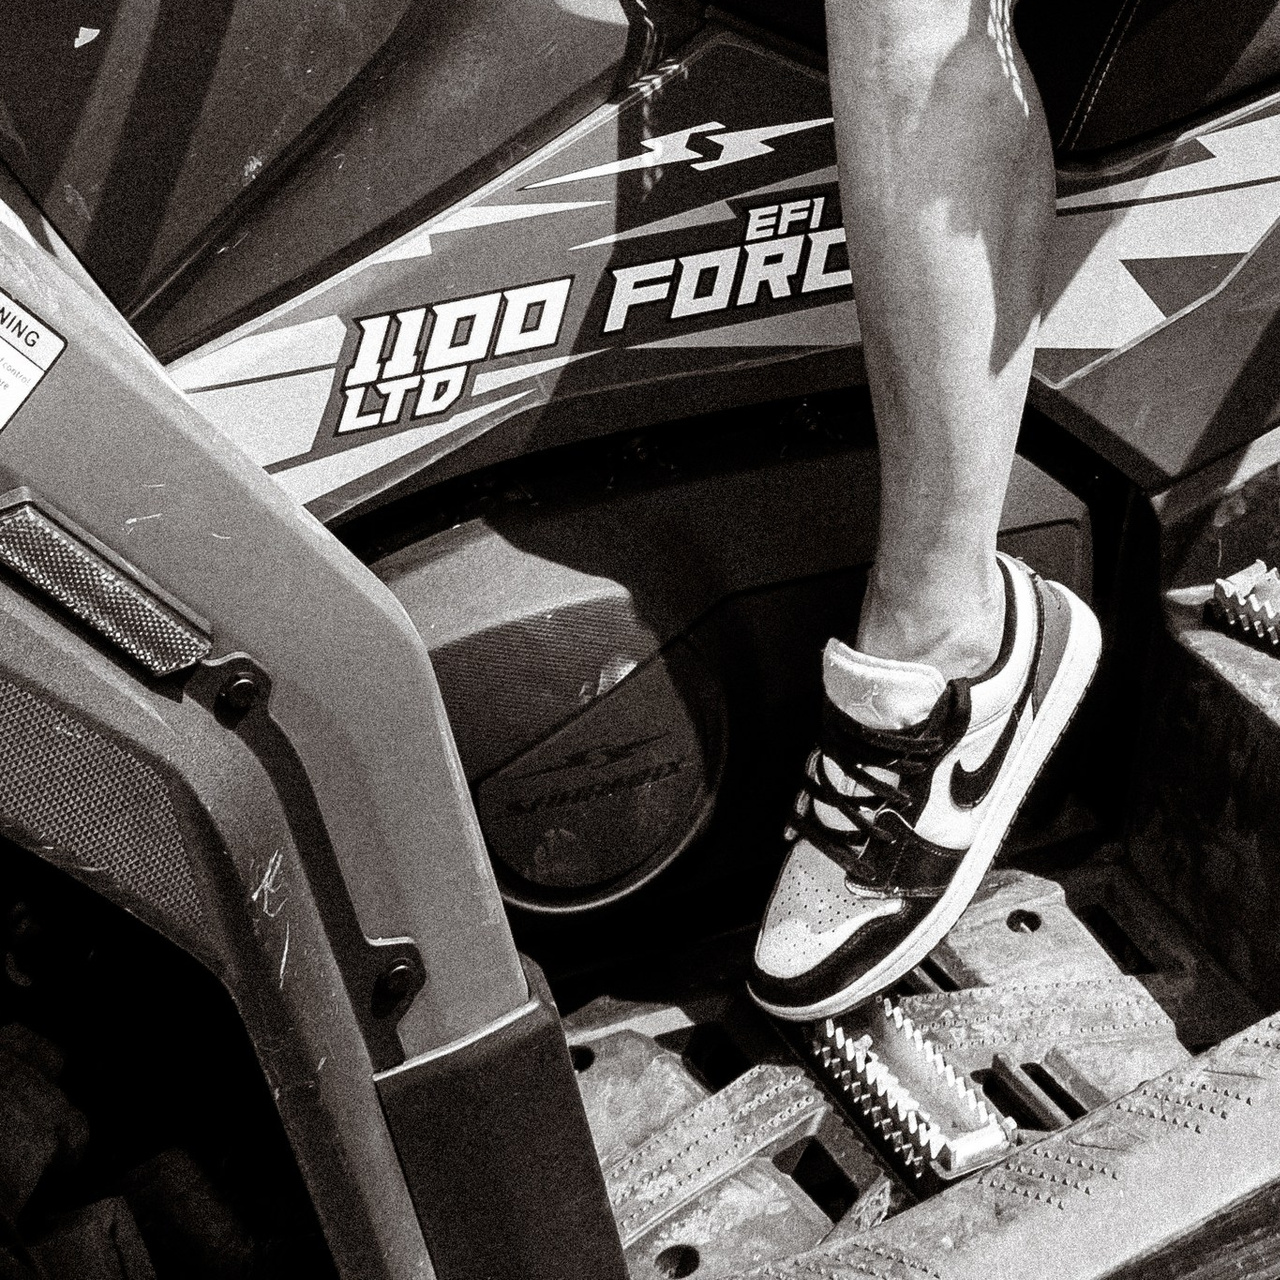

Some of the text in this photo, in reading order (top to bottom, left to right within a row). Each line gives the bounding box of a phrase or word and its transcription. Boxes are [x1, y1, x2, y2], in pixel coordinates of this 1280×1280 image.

[744, 196, 826, 241] EFI
[603, 227, 853, 333] FORC
[345, 278, 572, 388] 1100
[338, 365, 468, 434] LTD
